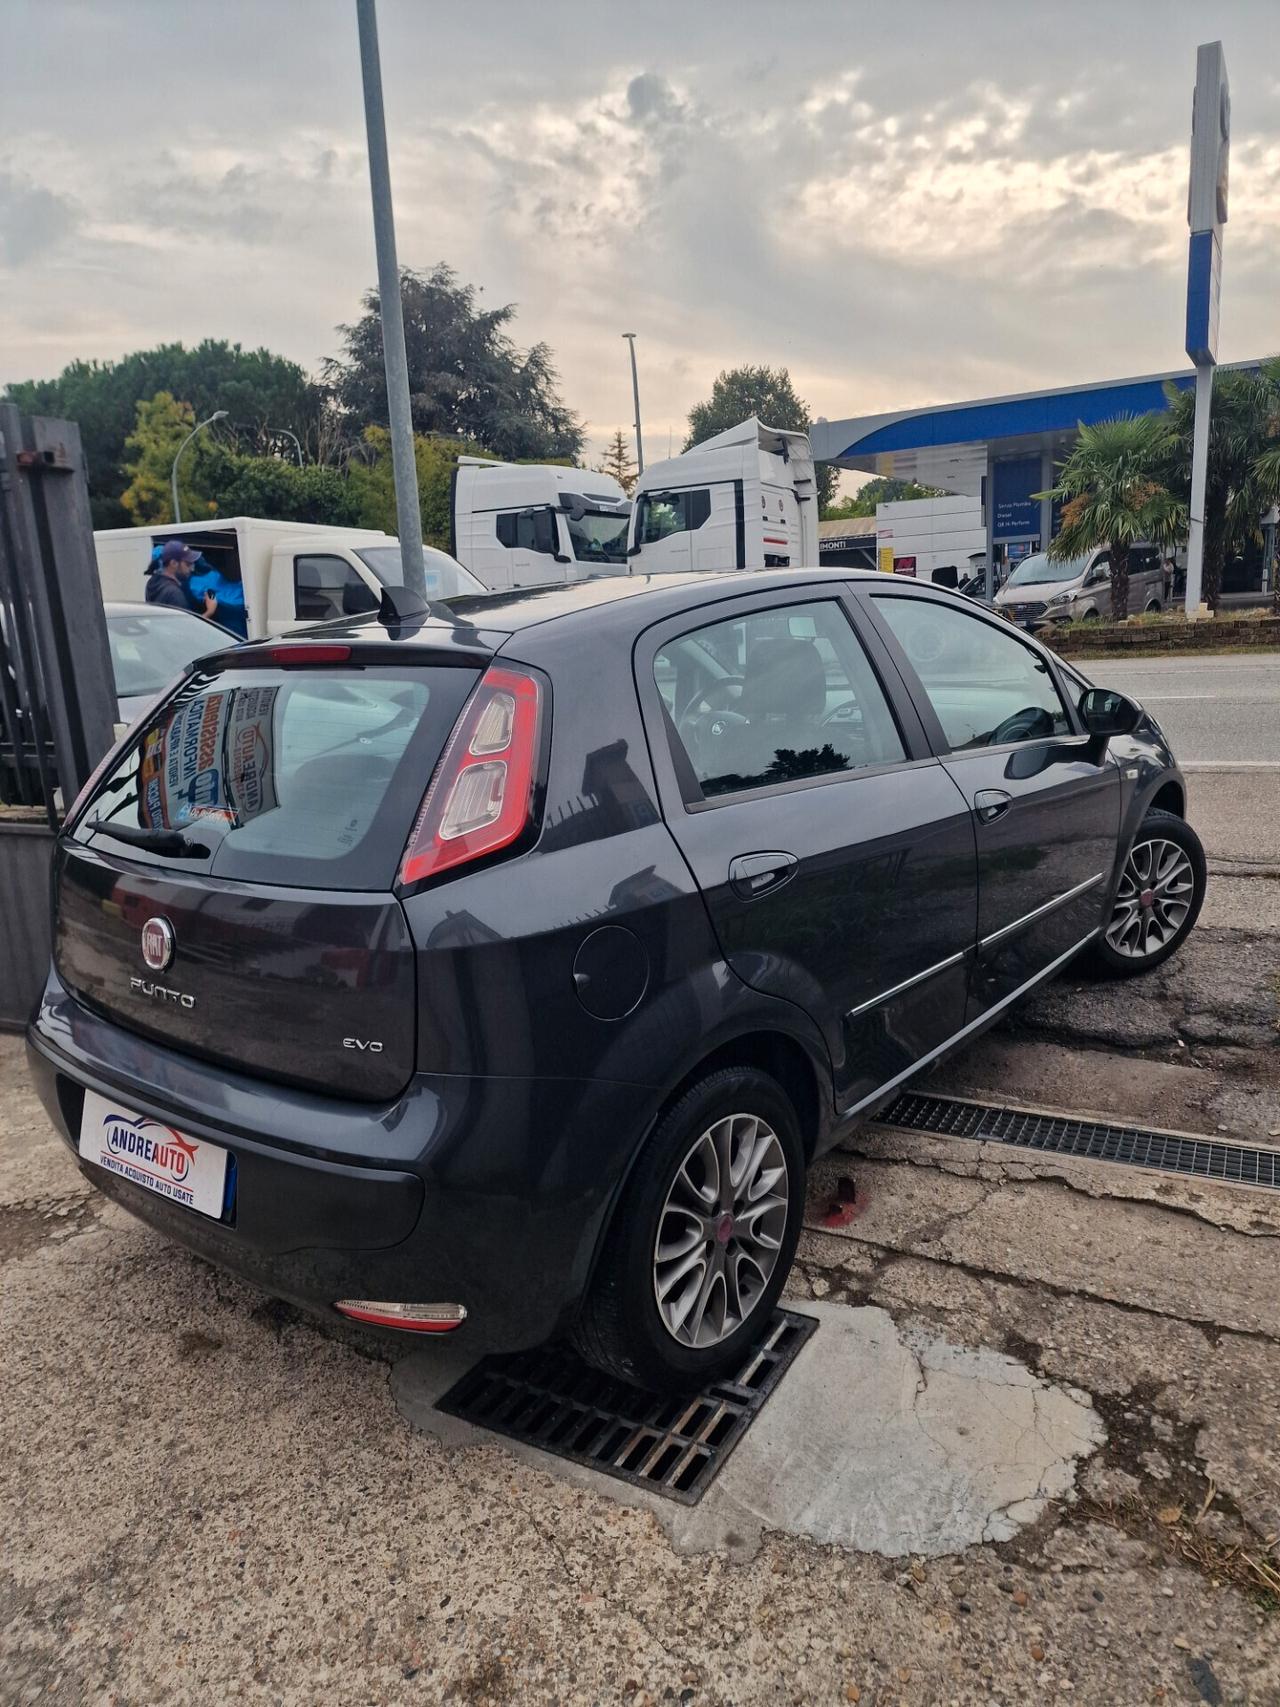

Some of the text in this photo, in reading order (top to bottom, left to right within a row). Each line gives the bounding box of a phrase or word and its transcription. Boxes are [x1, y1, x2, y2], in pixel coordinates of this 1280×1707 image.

[147, 933, 163, 957] FIAT
[130, 977, 195, 1009] PUNTO
[343, 1038, 383, 1053] EVO
[111, 1126, 186, 1175] ANDREAUTO
[100, 1155, 194, 1205] VENDITA ACQUISTO AUTO USATE
